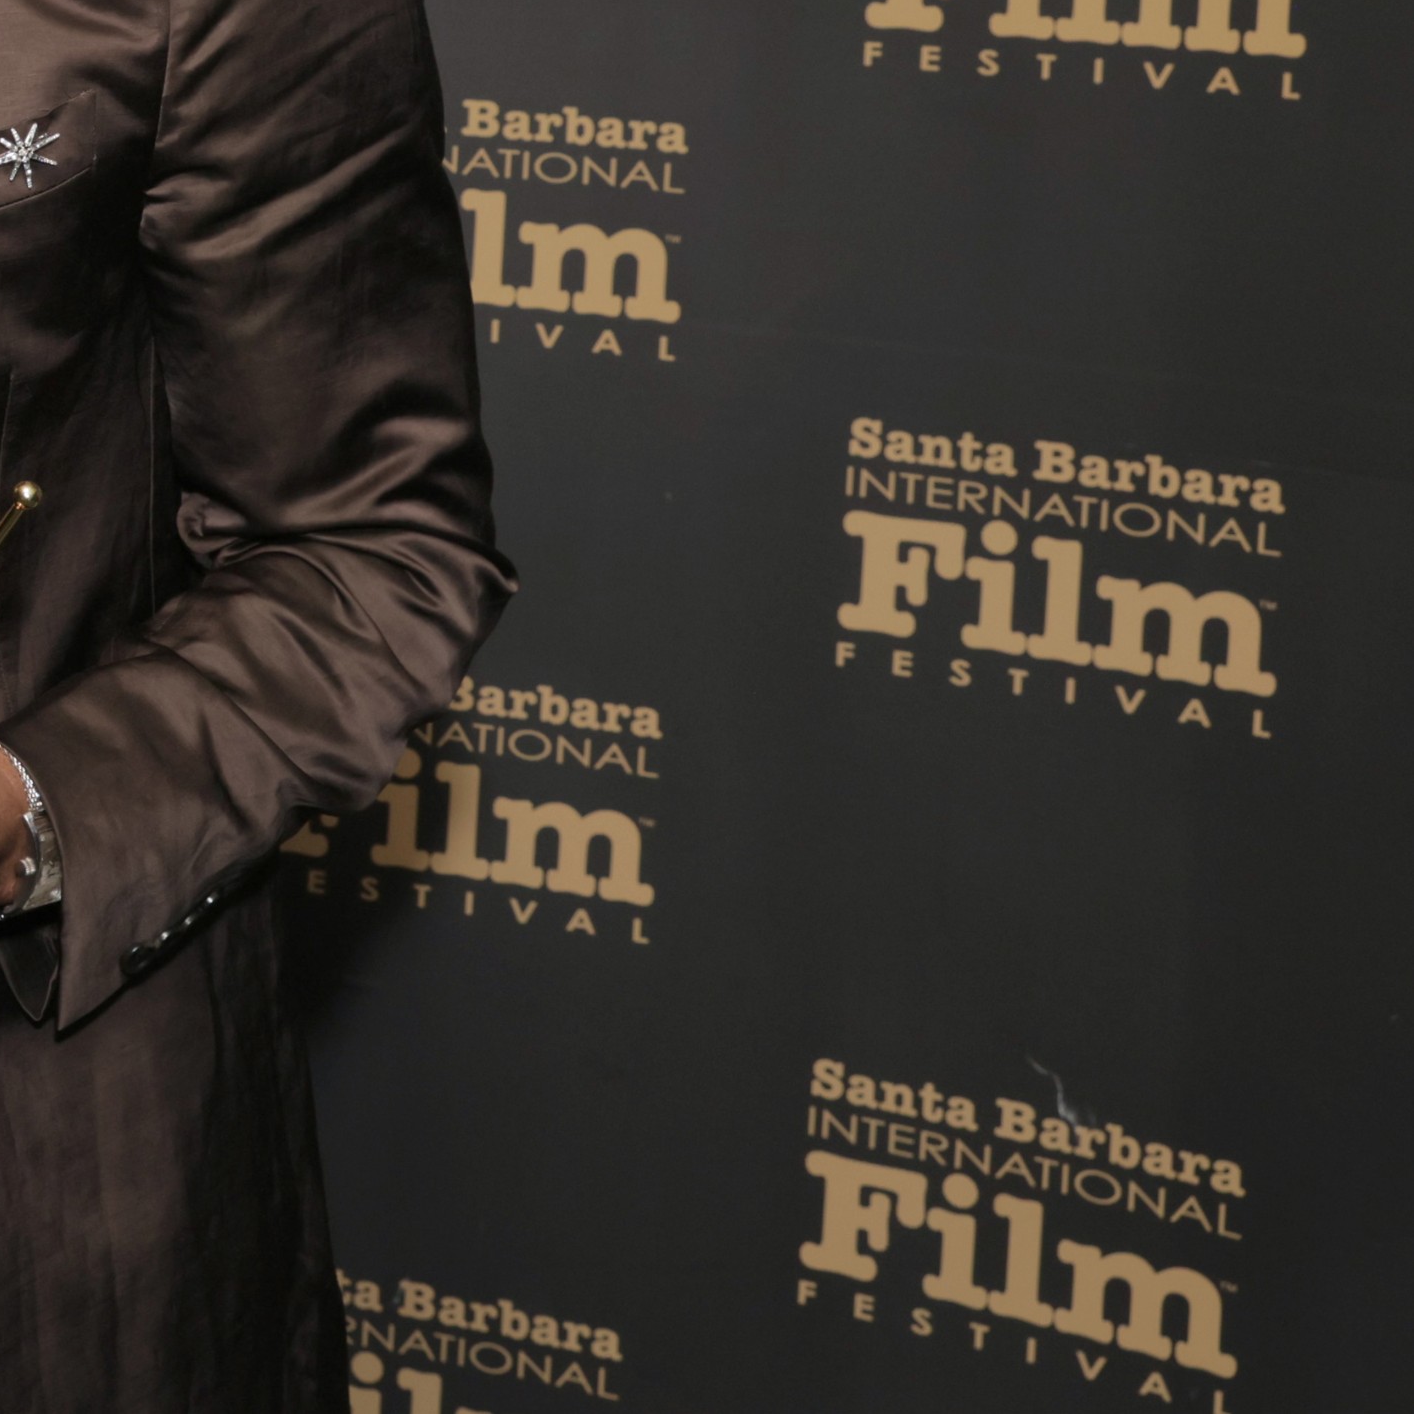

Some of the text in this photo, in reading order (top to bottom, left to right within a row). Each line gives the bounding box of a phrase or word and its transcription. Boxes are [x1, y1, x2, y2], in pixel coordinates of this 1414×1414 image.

[864, 42, 1300, 100] FESTIVAL
[442, 146, 685, 194] NATIONAL
[461, 99, 688, 154] Barbara
[460, 188, 681, 325] lm
[489, 318, 676, 362] IVAL
[849, 418, 1285, 514] Santa Barbara
[846, 468, 1280, 556] INTERNATIONAL
[838, 510, 1277, 697] Film
[836, 642, 1271, 738] FESTIVAL
[414, 721, 660, 779] ATIONAL
[307, 869, 651, 945] ESTIVAL
[812, 1059, 1245, 1197] Santa Barbara
[809, 1108, 1240, 1239] INTERNATIONAL
[800, 1151, 1237, 1378] Film
[346, 1315, 620, 1401] NATIONAL
[398, 1279, 622, 1361] Barbara
[798, 1280, 1232, 1414] FESTIVAL
